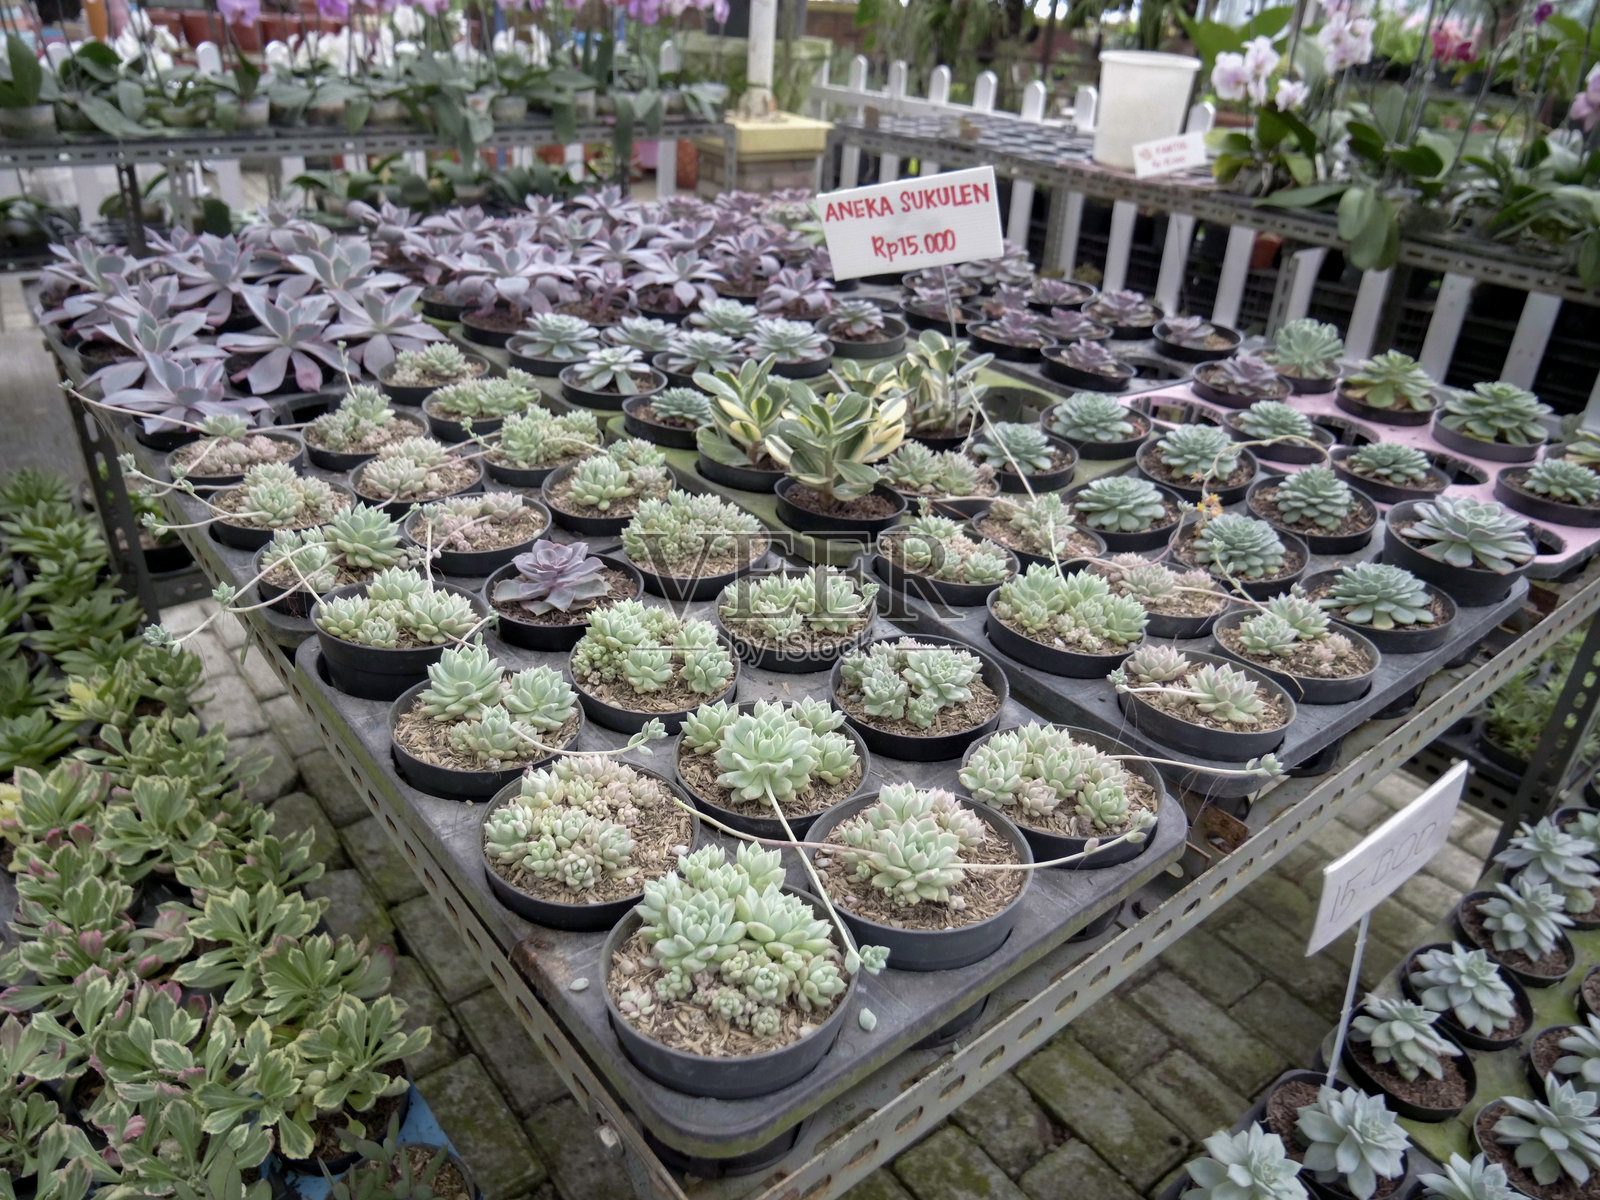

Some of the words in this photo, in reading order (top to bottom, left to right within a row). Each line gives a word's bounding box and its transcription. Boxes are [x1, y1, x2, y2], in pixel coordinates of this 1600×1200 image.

[825, 196, 894, 222] ANEKA
[900, 183, 989, 212] SUKULEN
[871, 229, 956, 262] Rp15.000
